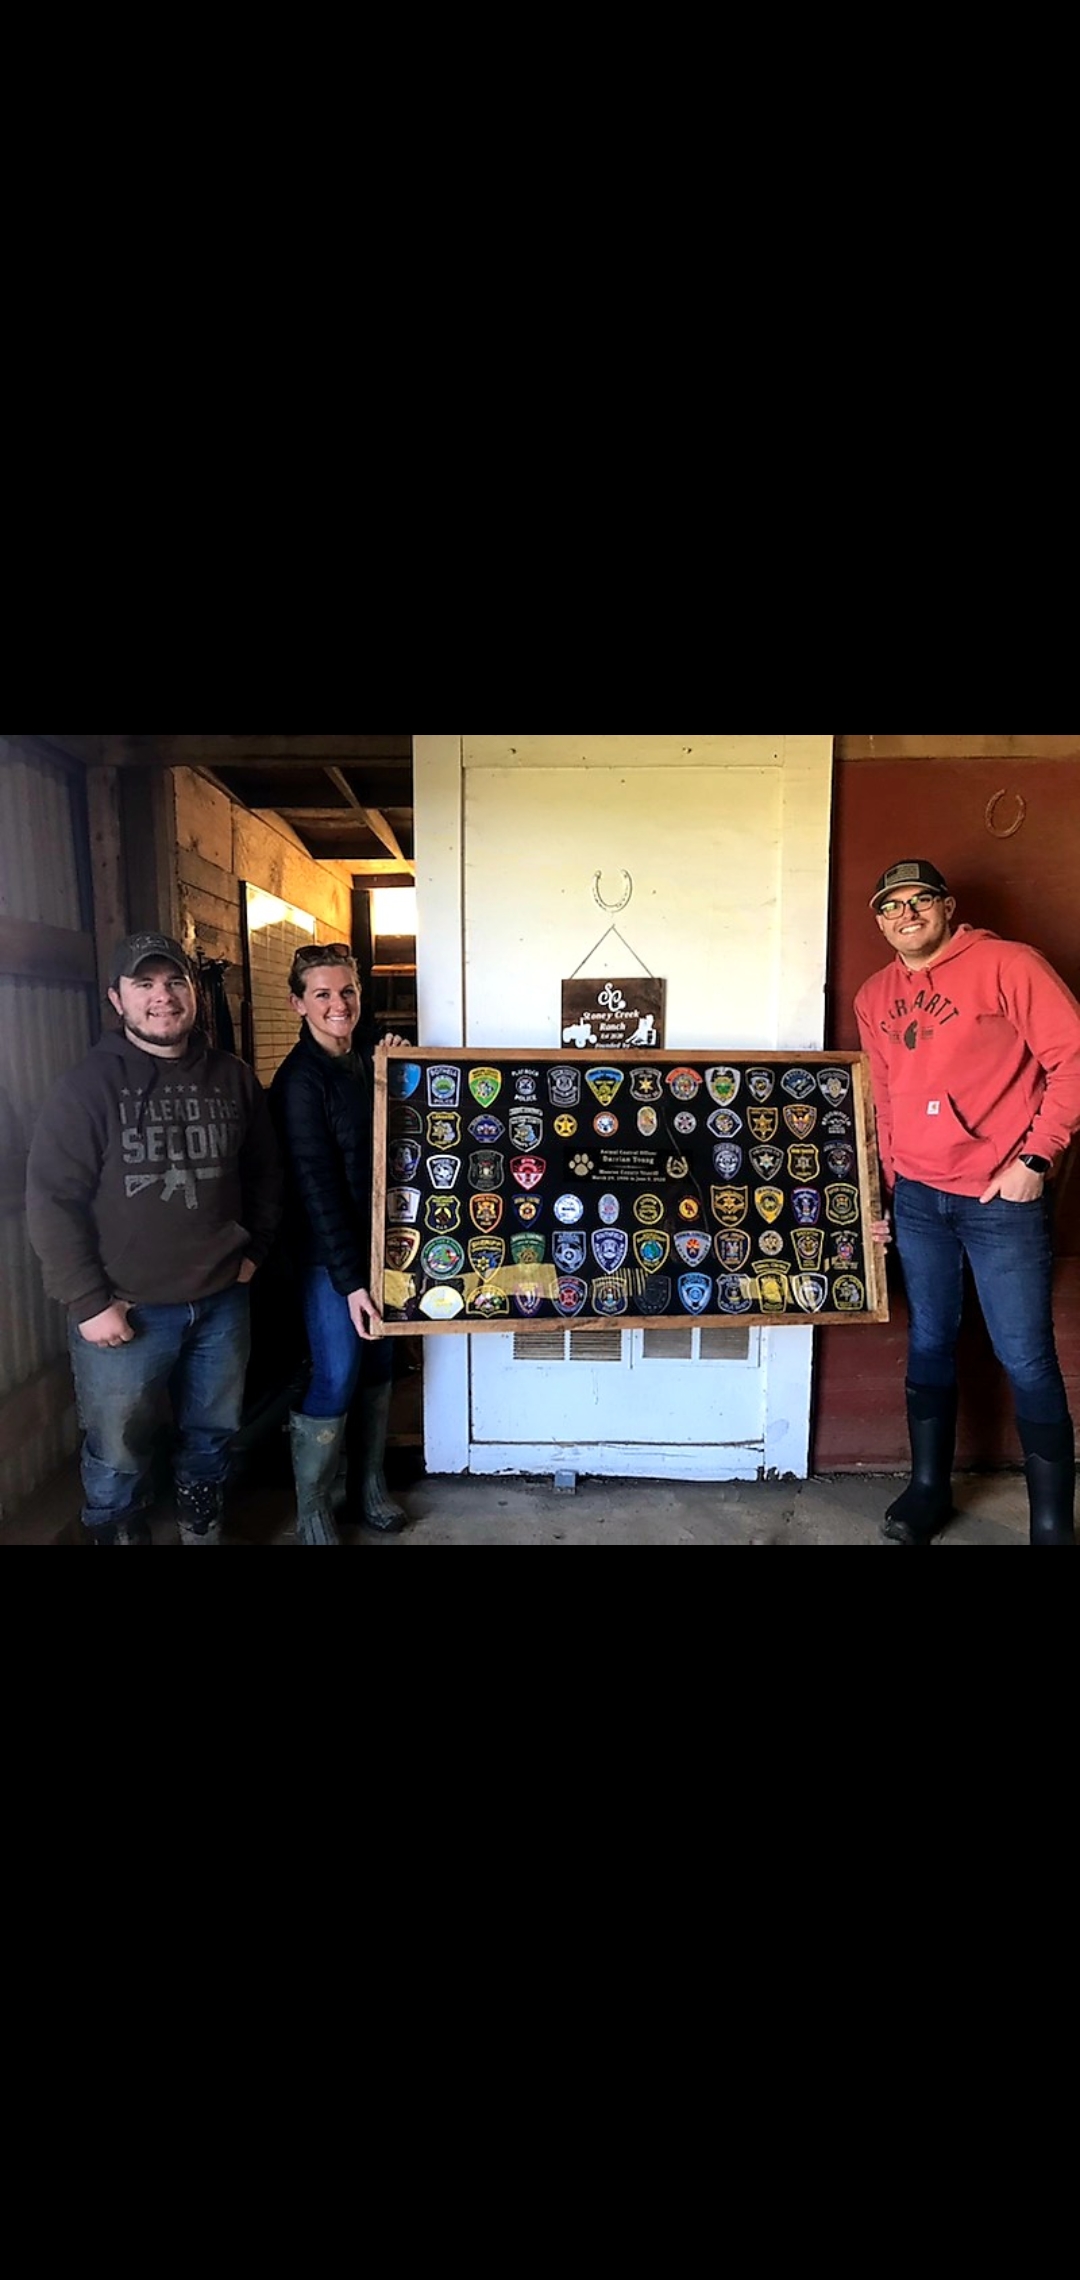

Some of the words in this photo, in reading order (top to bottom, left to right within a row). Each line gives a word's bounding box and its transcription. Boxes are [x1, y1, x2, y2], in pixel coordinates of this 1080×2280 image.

[583, 1011, 612, 1022] Stoney
[614, 1009, 640, 1019] Creek
[880, 989, 959, 1032] CRARTT
[599, 1022, 626, 1031] Ranch
[119, 1101, 127, 1125] I
[204, 1098, 239, 1119] THE
